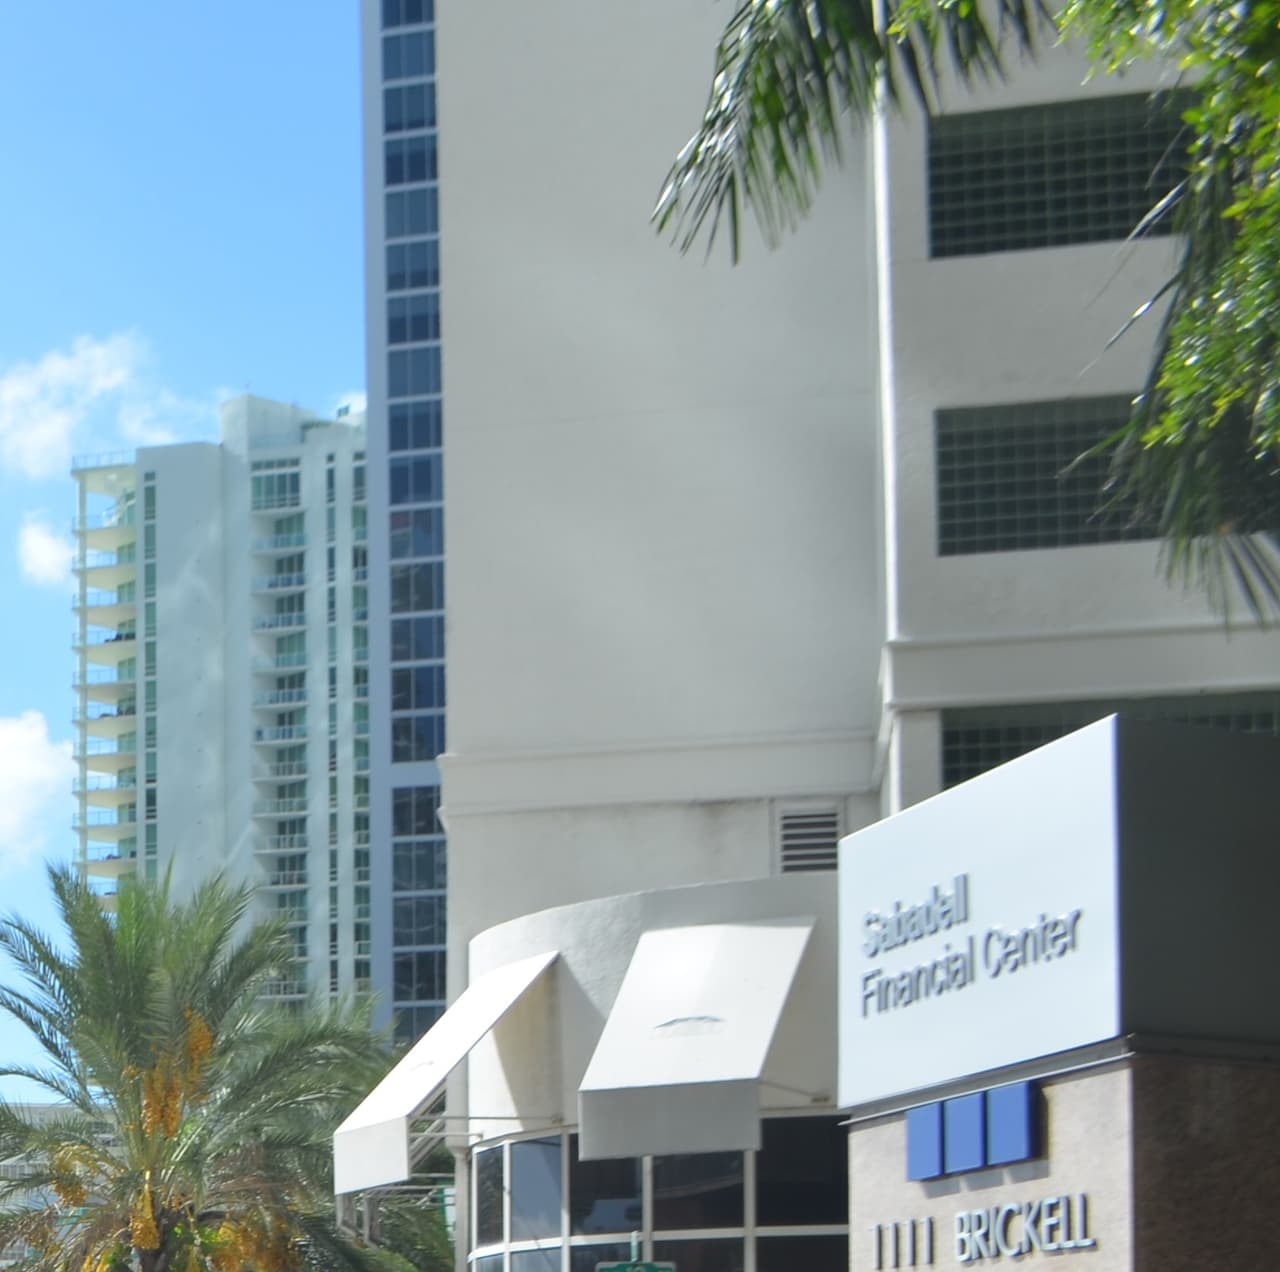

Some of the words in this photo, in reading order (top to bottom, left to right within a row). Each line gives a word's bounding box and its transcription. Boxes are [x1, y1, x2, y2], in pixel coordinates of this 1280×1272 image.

[863, 872, 970, 958] Sabadell
[861, 936, 976, 1018] Financial
[983, 908, 1082, 978] Center
[869, 1215, 936, 1271] 1111
[954, 1193, 1097, 1262] BRICKELL
